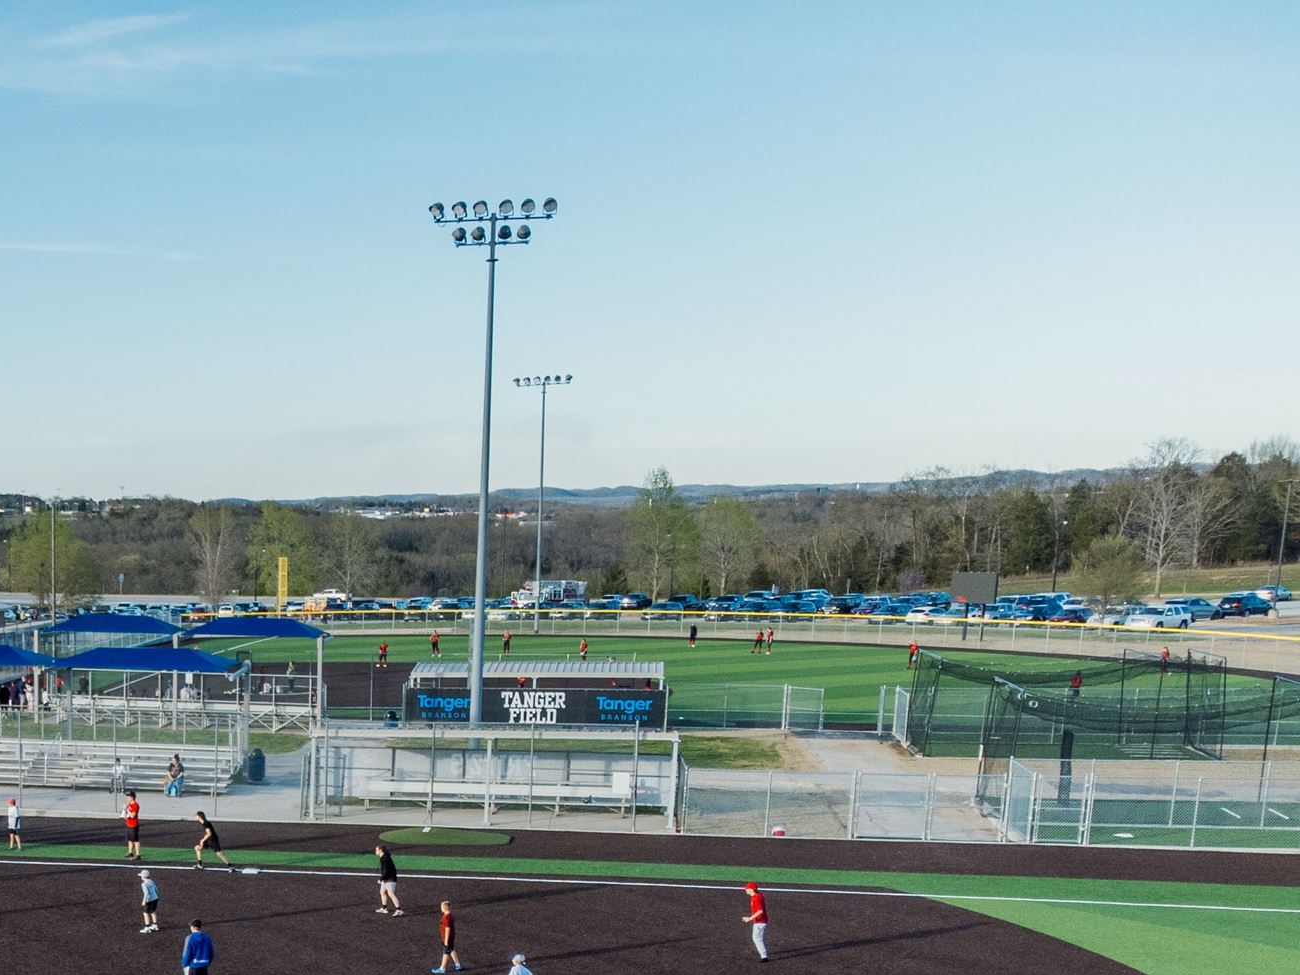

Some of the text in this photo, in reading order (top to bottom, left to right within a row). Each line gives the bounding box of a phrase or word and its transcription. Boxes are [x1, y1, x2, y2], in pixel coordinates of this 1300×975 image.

[417, 694, 471, 711] Tanger
[501, 691, 566, 709] TANGER
[596, 696, 653, 713] Tanger
[421, 711, 467, 719] BRANSON
[508, 708, 557, 724] FIELD
[600, 714, 648, 722] BRANSON
